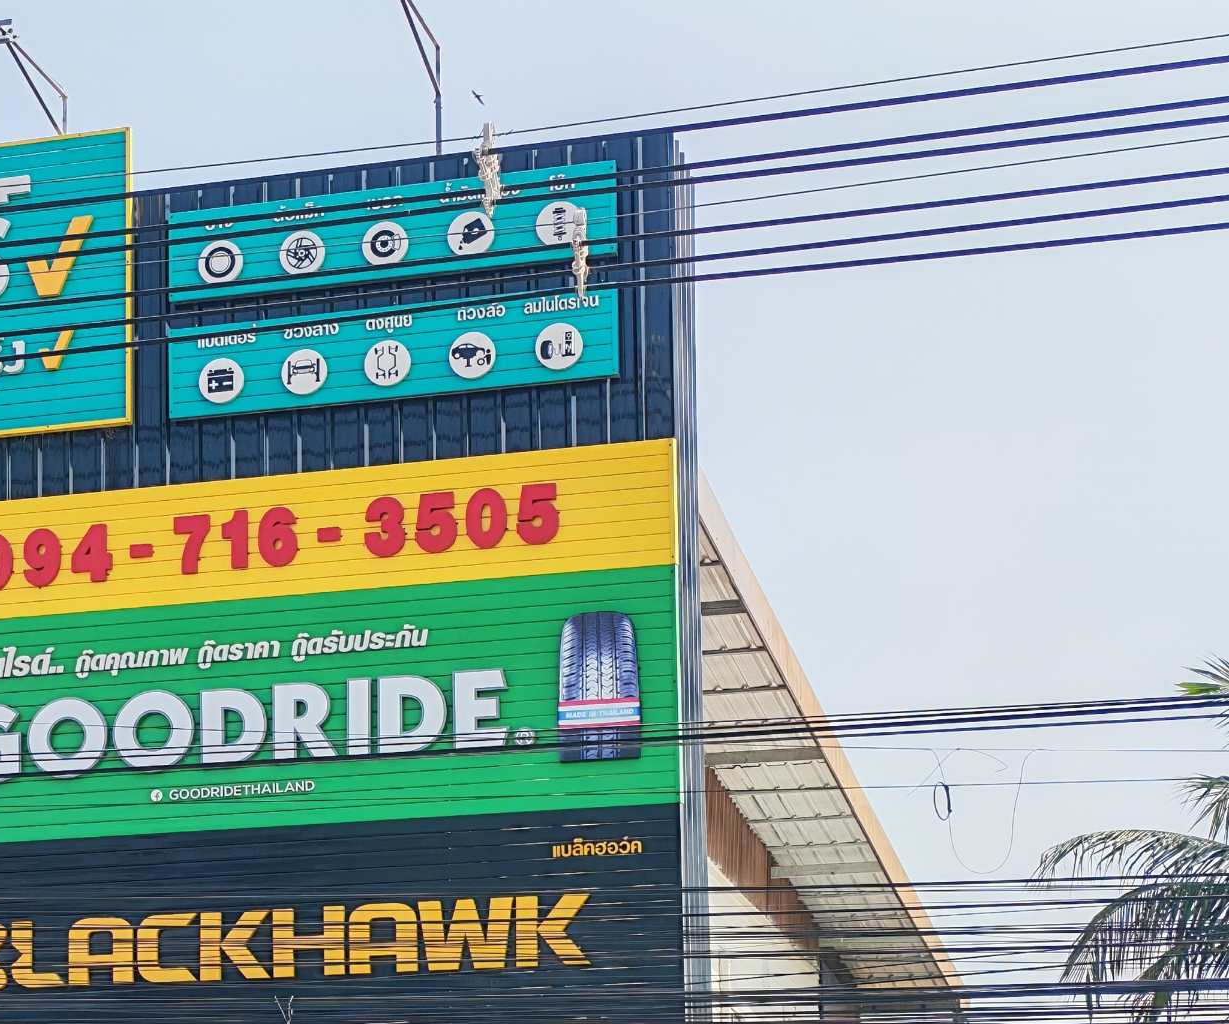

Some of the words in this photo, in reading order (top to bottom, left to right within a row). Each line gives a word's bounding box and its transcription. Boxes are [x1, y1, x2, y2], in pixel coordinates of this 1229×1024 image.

[75, 647, 189, 679] กู๊ดคุณภาพ
[197, 640, 281, 669] กู๊ดราคา
[291, 623, 429, 663] กู๊ดรับประกัน
[169, 780, 315, 801] GOODRIDETHAILAND
